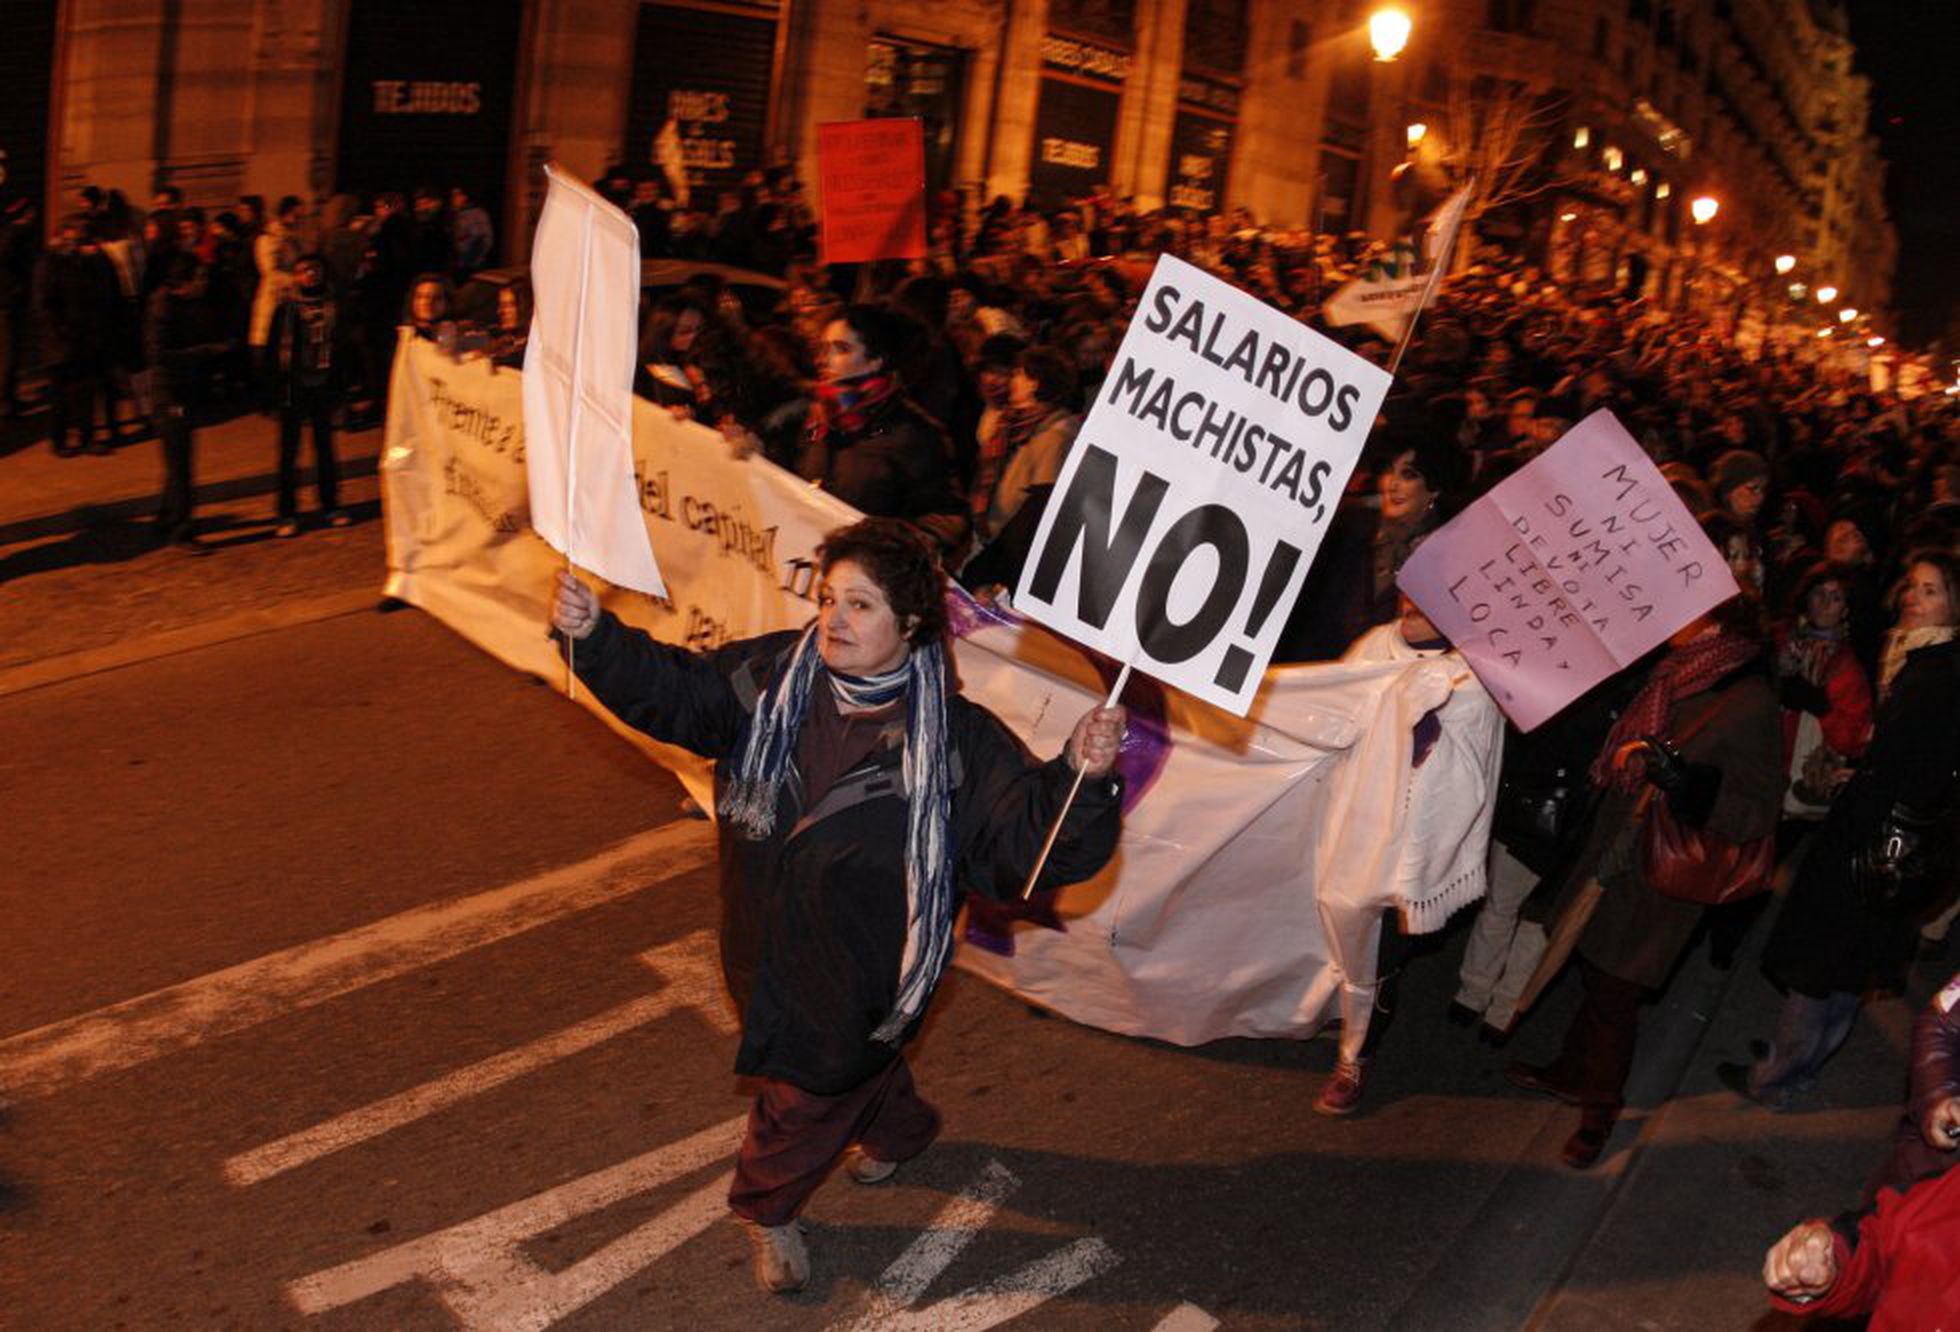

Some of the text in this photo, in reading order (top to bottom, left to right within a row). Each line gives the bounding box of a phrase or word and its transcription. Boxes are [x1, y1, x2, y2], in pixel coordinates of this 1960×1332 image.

[372, 81, 481, 114] TEJIDOS
[1144, 285, 1360, 433] SALARIOS
[1107, 357, 1332, 524] MACHISTAS,
[681, 495, 780, 582] capital
[1028, 443, 1302, 695] NO!
[1512, 515, 1612, 632] DEVOTA
[1545, 493, 1655, 624] SUMISA
[1601, 515, 1637, 556] NI
[1602, 463, 1704, 588] MUJER
[1449, 575, 1523, 670] LOCA
[1479, 559, 1559, 651] LINDA
[1504, 543, 1580, 629] LIBRE
